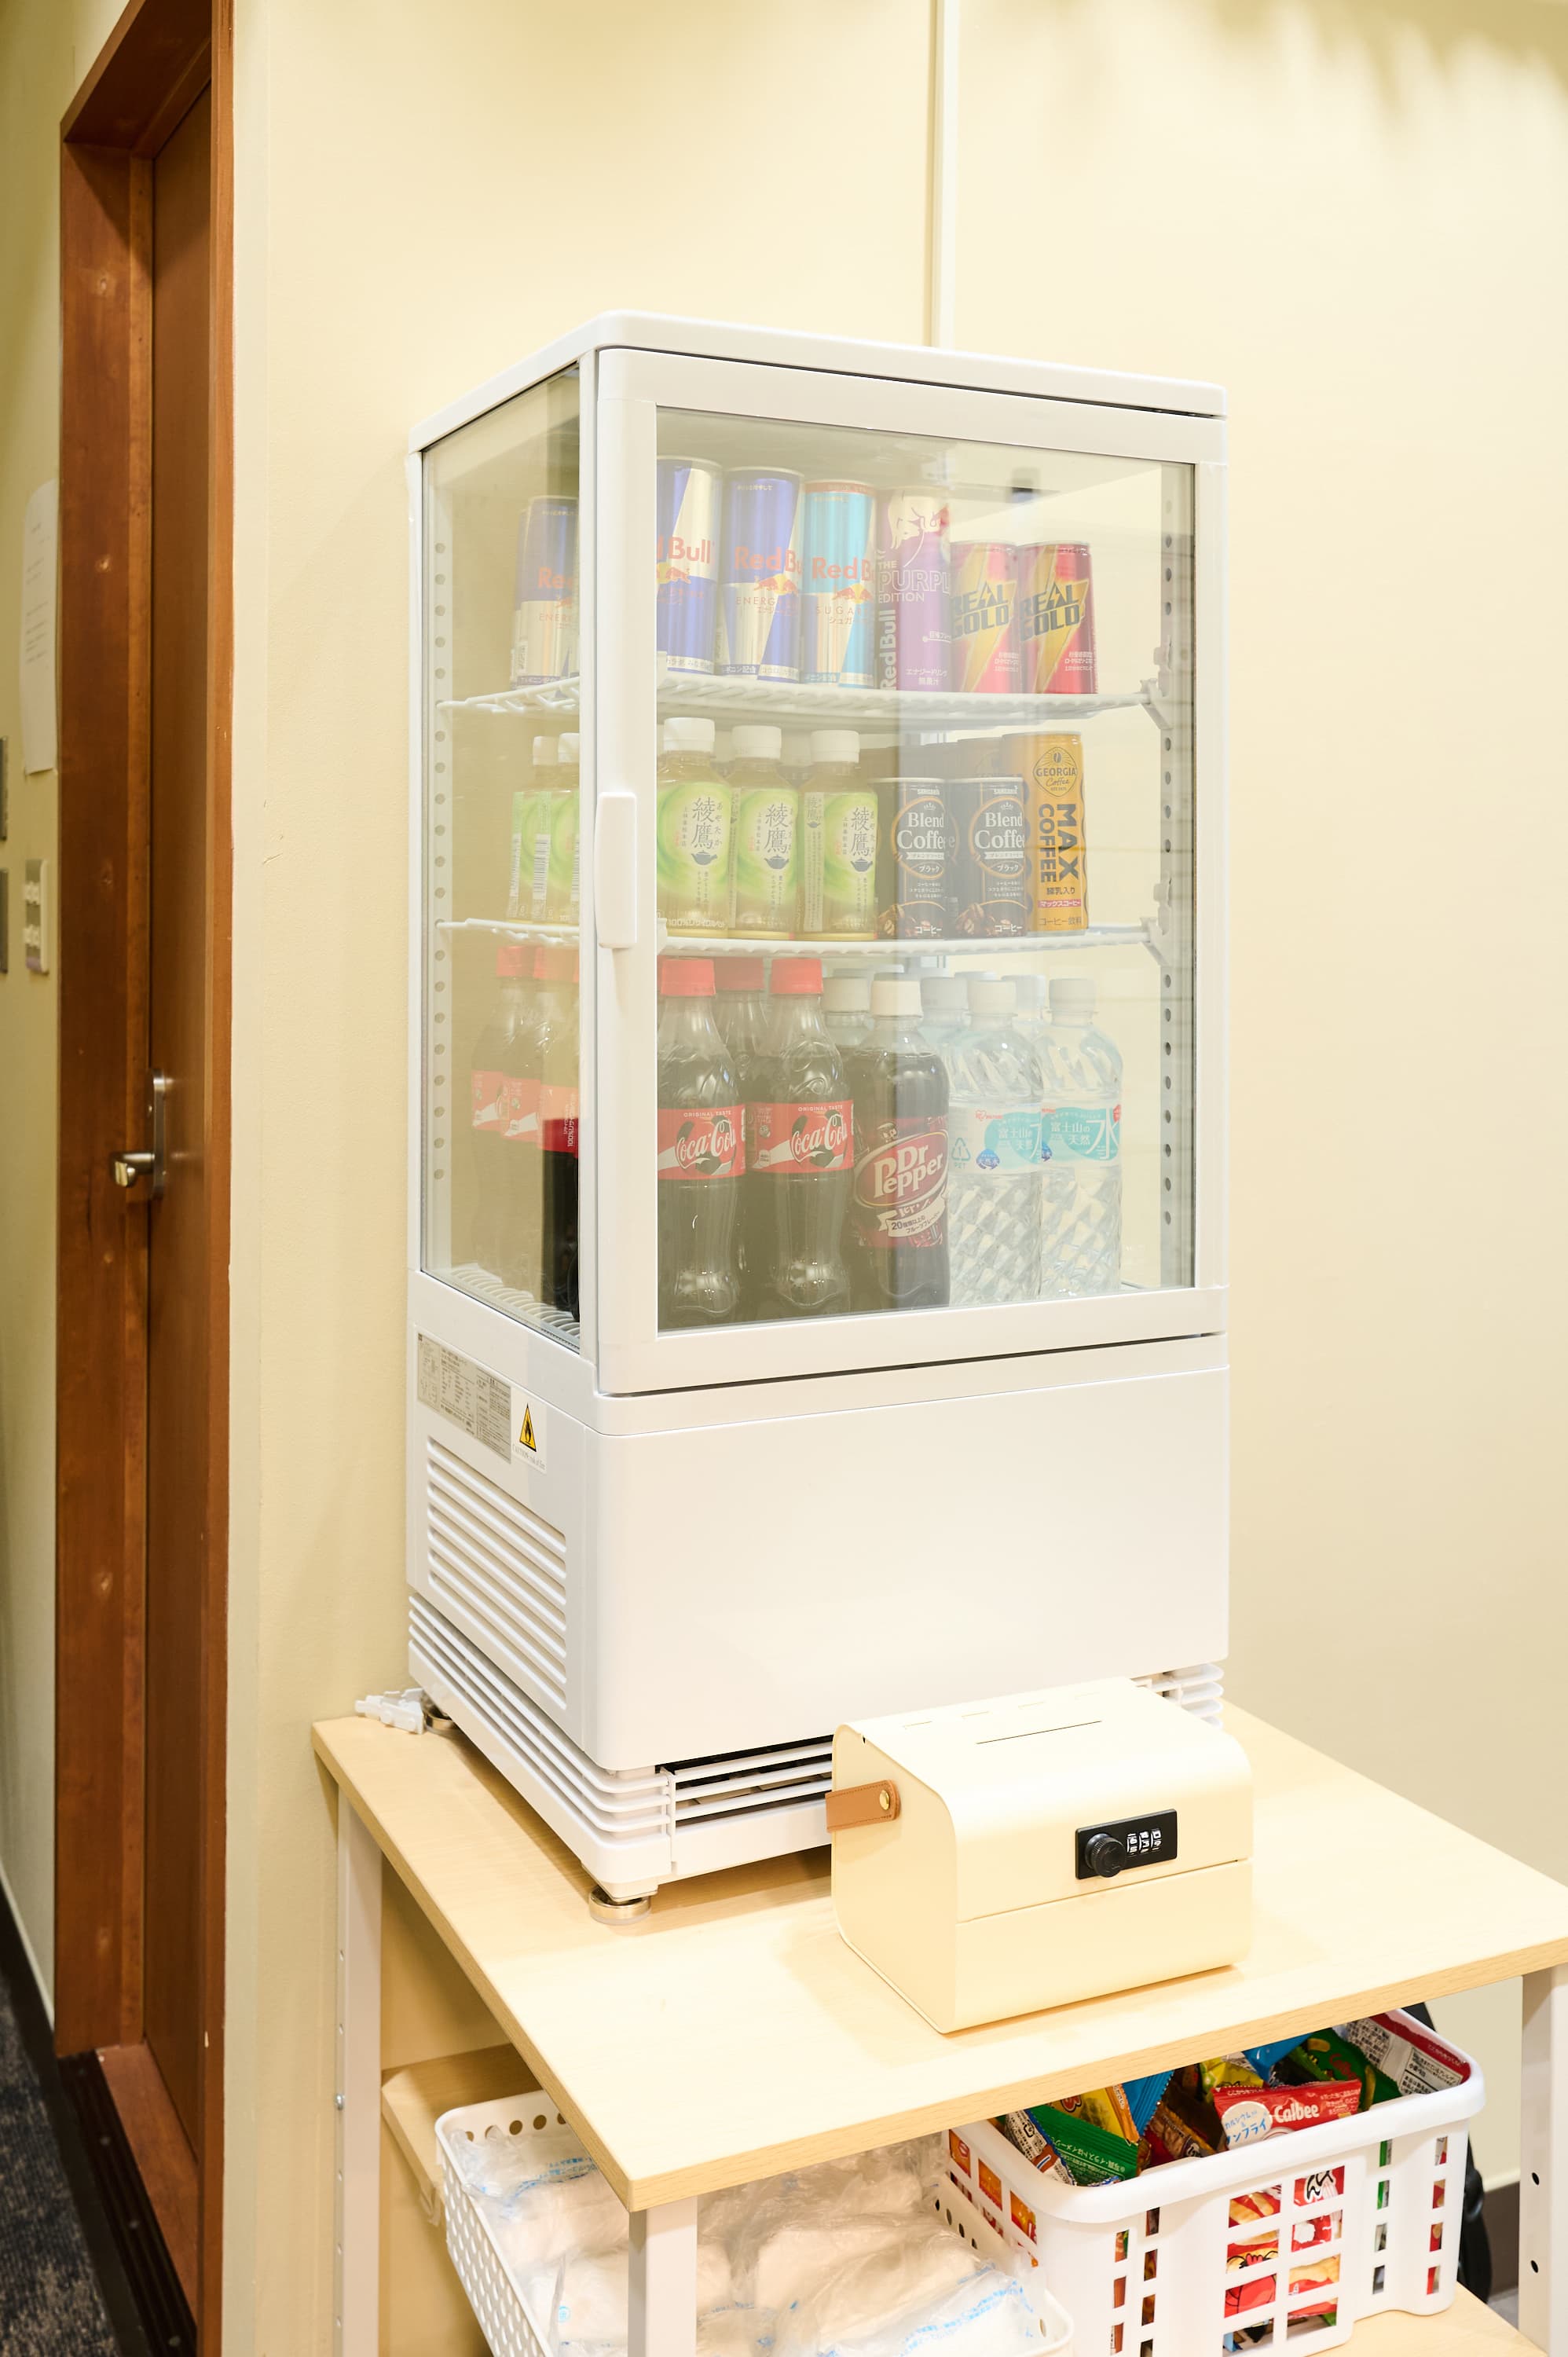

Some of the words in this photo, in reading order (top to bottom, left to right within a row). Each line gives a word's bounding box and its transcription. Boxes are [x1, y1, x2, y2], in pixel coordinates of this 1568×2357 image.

[671, 537, 711, 564] Bull
[735, 546, 781, 570] Red
[812, 557, 857, 580] Red
[878, 592, 925, 604] EDITION
[951, 581, 1009, 615] REAL
[1019, 581, 1079, 614] REAL
[880, 609, 896, 646] Bull
[951, 604, 1009, 640] GOLD
[1020, 603, 1080, 642] GOLD
[880, 647, 897, 690] Red
[1035, 767, 1076, 777] GEORGIA
[691, 797, 716, 849] 綾鷹
[764, 802, 789, 854] 綾鷹
[851, 806, 870, 856] 綾鷹
[907, 812, 944, 827] Blend
[985, 812, 1024, 827] Blend
[1038, 803, 1057, 883] COFFEE
[1056, 803, 1079, 881] MAX
[916, 926, 942, 934] コーヒー
[995, 924, 1023, 933] コーヒー
[1050, 1122, 1090, 1133] 富士山の
[1068, 1135, 1090, 1146] 天然
[1086, 1108, 1121, 1160] 水
[873, 1152, 943, 1199] Pepper
[897, 1144, 929, 1175] Dr
[1274, 2102, 1320, 2123] Calbee
